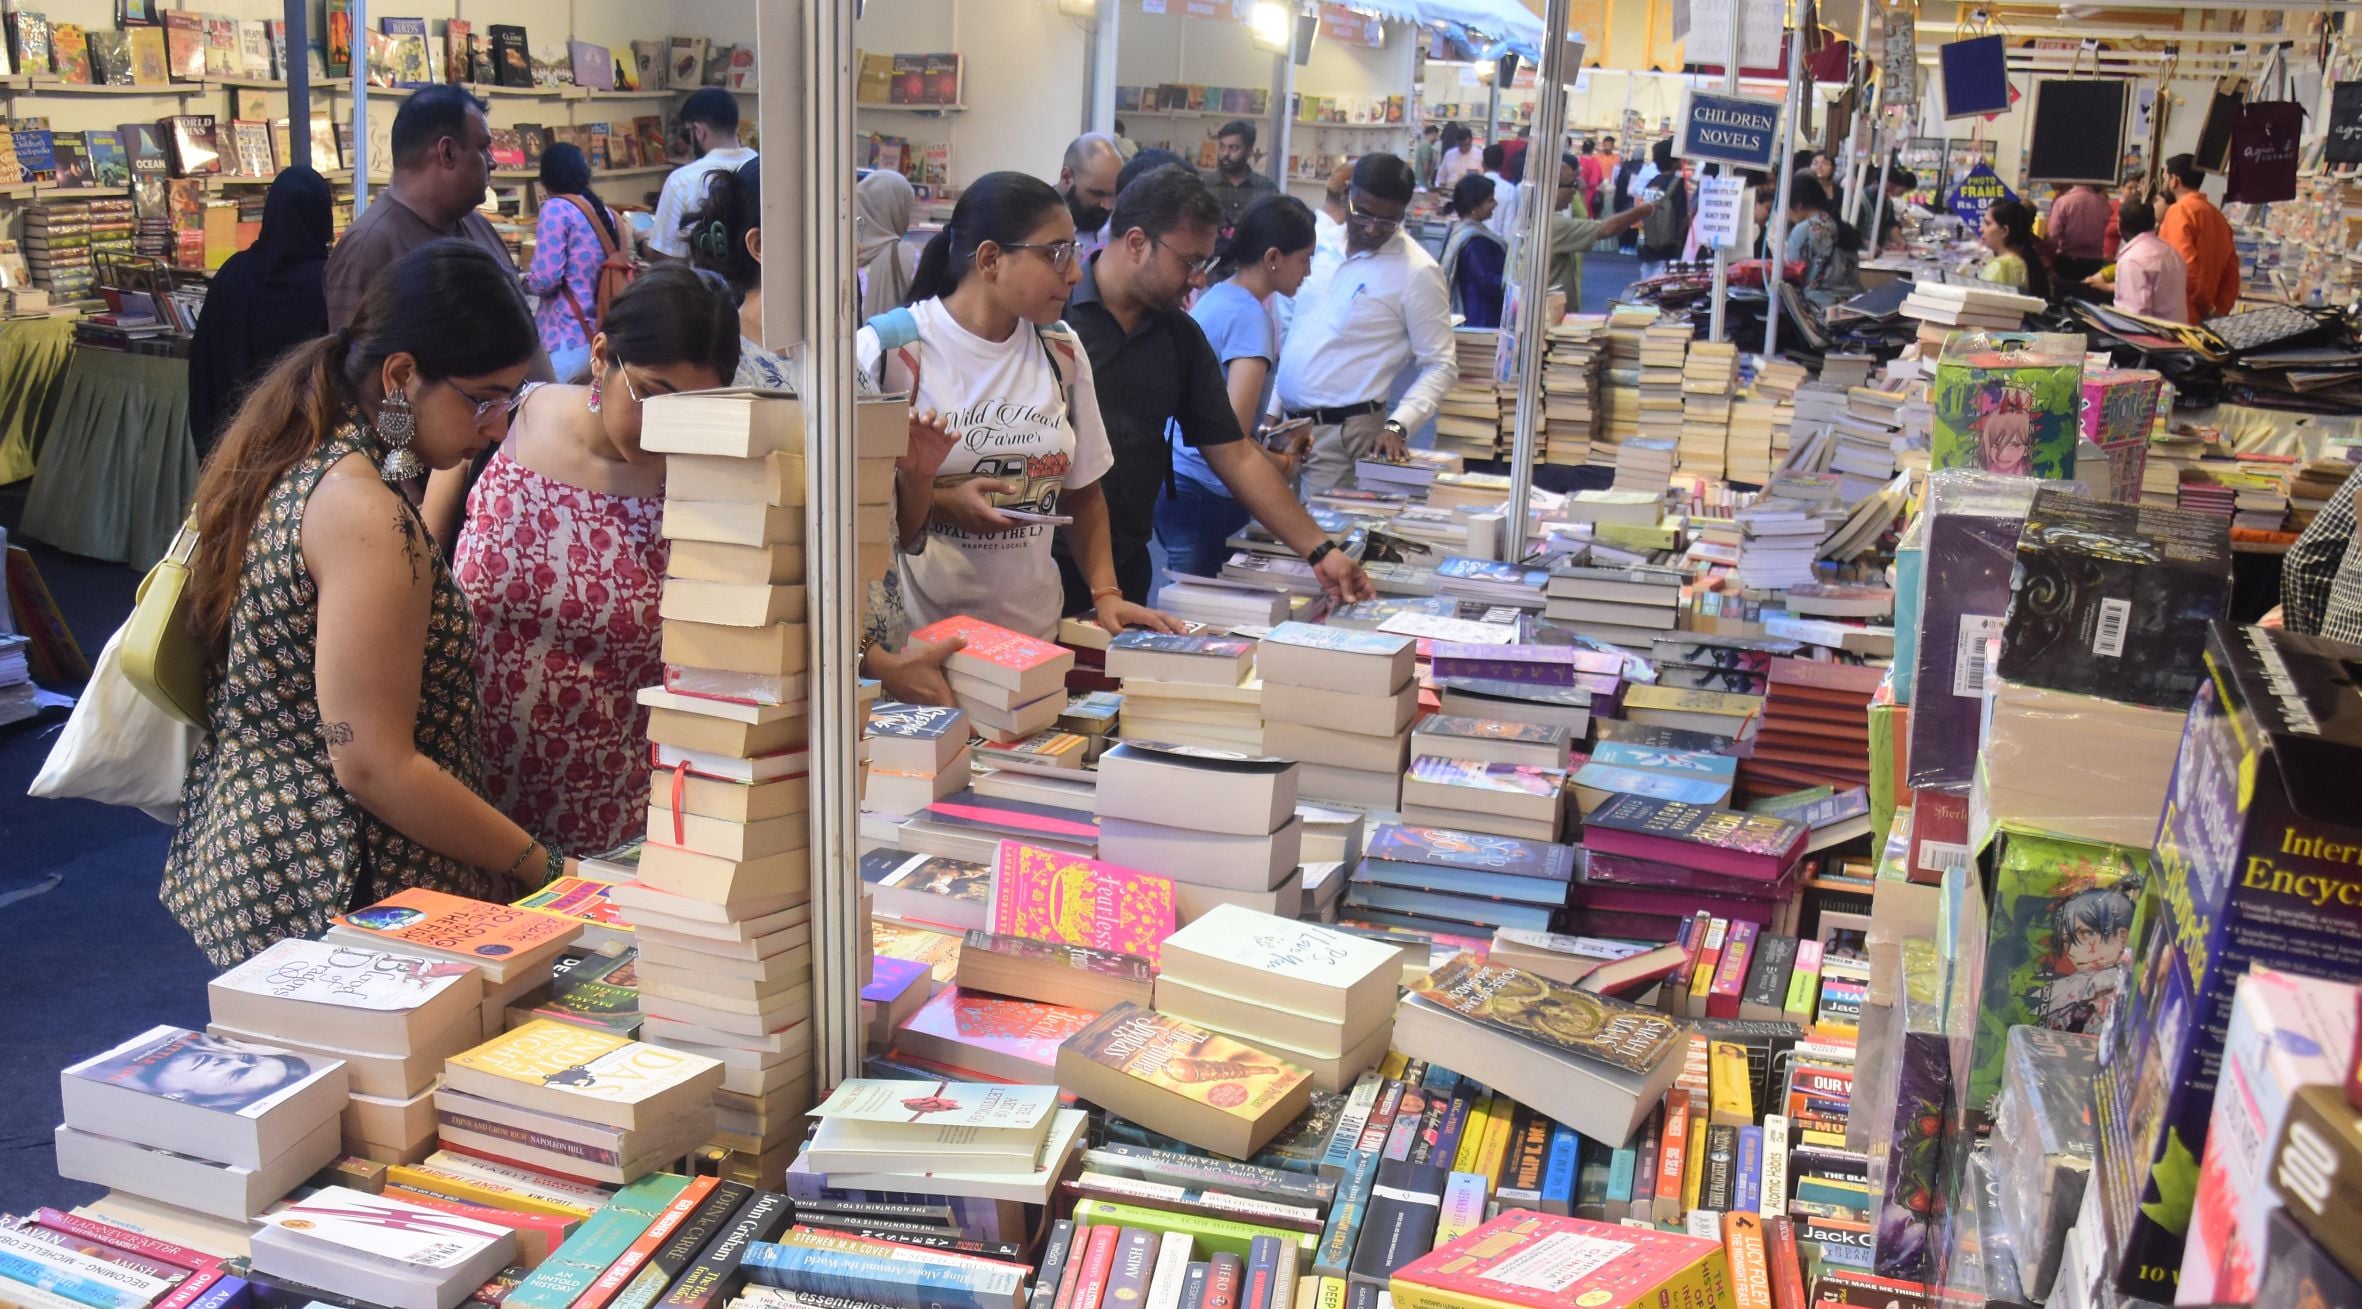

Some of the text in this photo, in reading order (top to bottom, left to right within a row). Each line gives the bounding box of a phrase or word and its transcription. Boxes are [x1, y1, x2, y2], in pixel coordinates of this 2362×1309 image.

[393, 23, 419, 33] BIRDS
[1694, 107, 1772, 129] CHILDREN
[1700, 128, 1760, 148] NOVELS
[136, 160, 166, 169] OCEAN
[1960, 186, 2005, 198] FRAME
[1967, 177, 1996, 185] PHOTO
[1957, 201, 1976, 209] Rs.
[944, 398, 1062, 432] Wild Heart
[964, 427, 1041, 455] Farmer
[932, 523, 1027, 540] OYAL TO THE
[875, 712, 914, 730] KING
[2281, 828, 2362, 866] Inter
[2240, 856, 2362, 906] Encyc
[434, 908, 523, 950] SO LONG
[273, 946, 378, 997] Dragons
[333, 953, 409, 997] Blood
[1594, 1017, 1631, 1047] MAAS
[484, 1024, 569, 1067] NIGHT
[521, 1030, 617, 1077] INDIA
[577, 1048, 685, 1099] DAS
[1814, 1077, 1843, 1092] OUR
[451, 1114, 527, 1142] THINK AND GROW RICH
[1331, 1113, 1363, 1158] LOSING HOPE
[530, 1135, 584, 1155] NAPOLEON HILL
[1151, 1149, 1275, 1176] PAULA HAWKINS
[1517, 1155, 1542, 1189] PHILIP
[2280, 1122, 2339, 1214] 100
[416, 1165, 462, 1187] RADICAL
[527, 1190, 545, 1203] KIM
[545, 1195, 574, 1209] SCOTT
[1765, 1152, 1783, 1209] Atomic Habits
[1825, 1171, 1844, 1181] THE
[711, 1187, 738, 1218] JOHN
[837, 1202, 856, 1210] YOU
[869, 1204, 911, 1213] MOUNTAIN
[913, 1206, 926, 1214] THE
[0, 1215, 66, 1246] RAAVAN
[710, 1194, 779, 1262] John Grisham
[844, 1217, 863, 1225] YOU
[878, 1222, 920, 1231] MOUNTAIN
[793, 1232, 834, 1249] STEPHEN
[860, 1243, 891, 1257] COVEY
[861, 1229, 950, 1248] MASTERY
[1331, 1235, 1345, 1253] FIRST
[1802, 1227, 1856, 1245] Jack
[23, 1247, 78, 1265] MICHELLE
[618, 1249, 643, 1270] BIG
[803, 1255, 842, 1268] World
[1048, 1241, 1063, 1266] CURTAIN
[1743, 1237, 1758, 1265] LUCY
[112, 1256, 156, 1277] AMISH
[860, 1263, 900, 1277] Around
[903, 1266, 938, 1280] Alone
[1124, 1246, 1145, 1280] AMISH
[1731, 1233, 1750, 1307] THE MIDNIGHT FEAST
[2138, 1263, 2166, 1281] 10
[88, 1262, 151, 1290] BECOMING
[186, 1274, 211, 1292] ONE
[530, 1278, 578, 1293] HISTORY
[538, 1273, 581, 1291] UNTOLD
[558, 1271, 573, 1280] AN
[599, 1265, 625, 1291] SEAN
[1220, 1263, 1233, 1293] HERO
[1714, 1269, 1726, 1300] THE
[1823, 1275, 1850, 1287] DON'T
[1851, 1279, 1878, 1291] MAKE
[1879, 1284, 1893, 1293] ME
[683, 1280, 711, 1305] Boys
[1325, 1285, 1338, 1308] DEEP
[1694, 1288, 1704, 1308] OF
[1747, 1266, 1770, 1308] FOLEY
